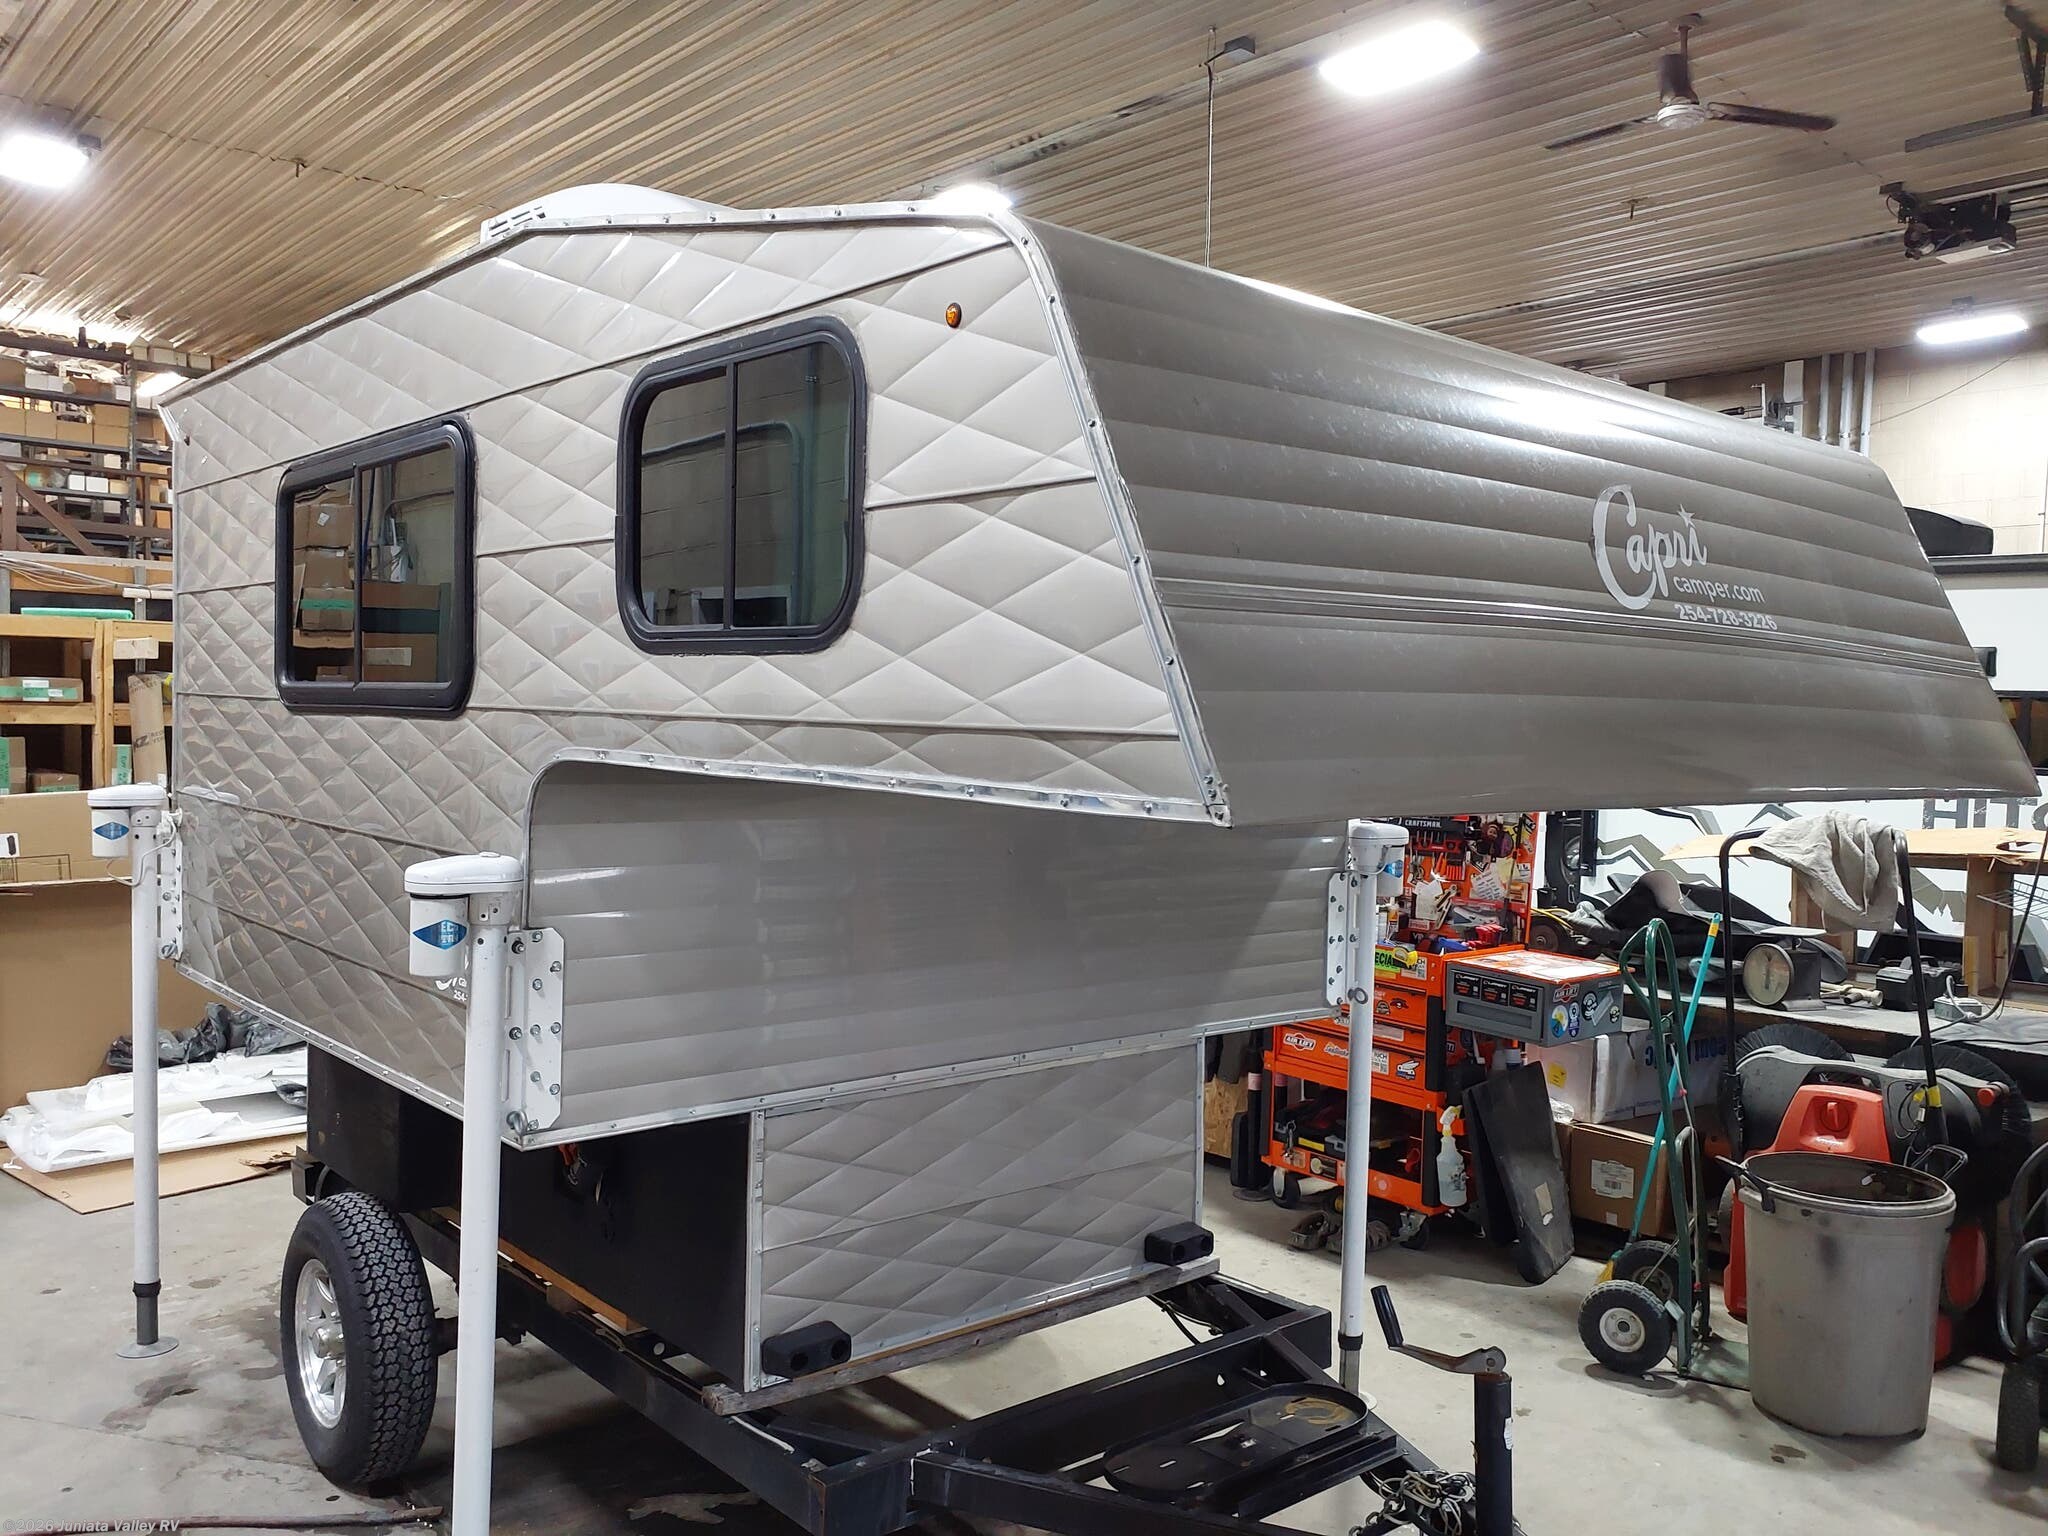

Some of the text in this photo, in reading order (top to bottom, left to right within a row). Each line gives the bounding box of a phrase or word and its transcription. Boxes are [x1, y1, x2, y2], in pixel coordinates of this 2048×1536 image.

[1592, 484, 1707, 611] Capri
[1673, 575, 1766, 603] camper.com
[1674, 603, 1778, 631] 254-728-3226
[1405, 819, 1441, 828] CRAFTSMAN
